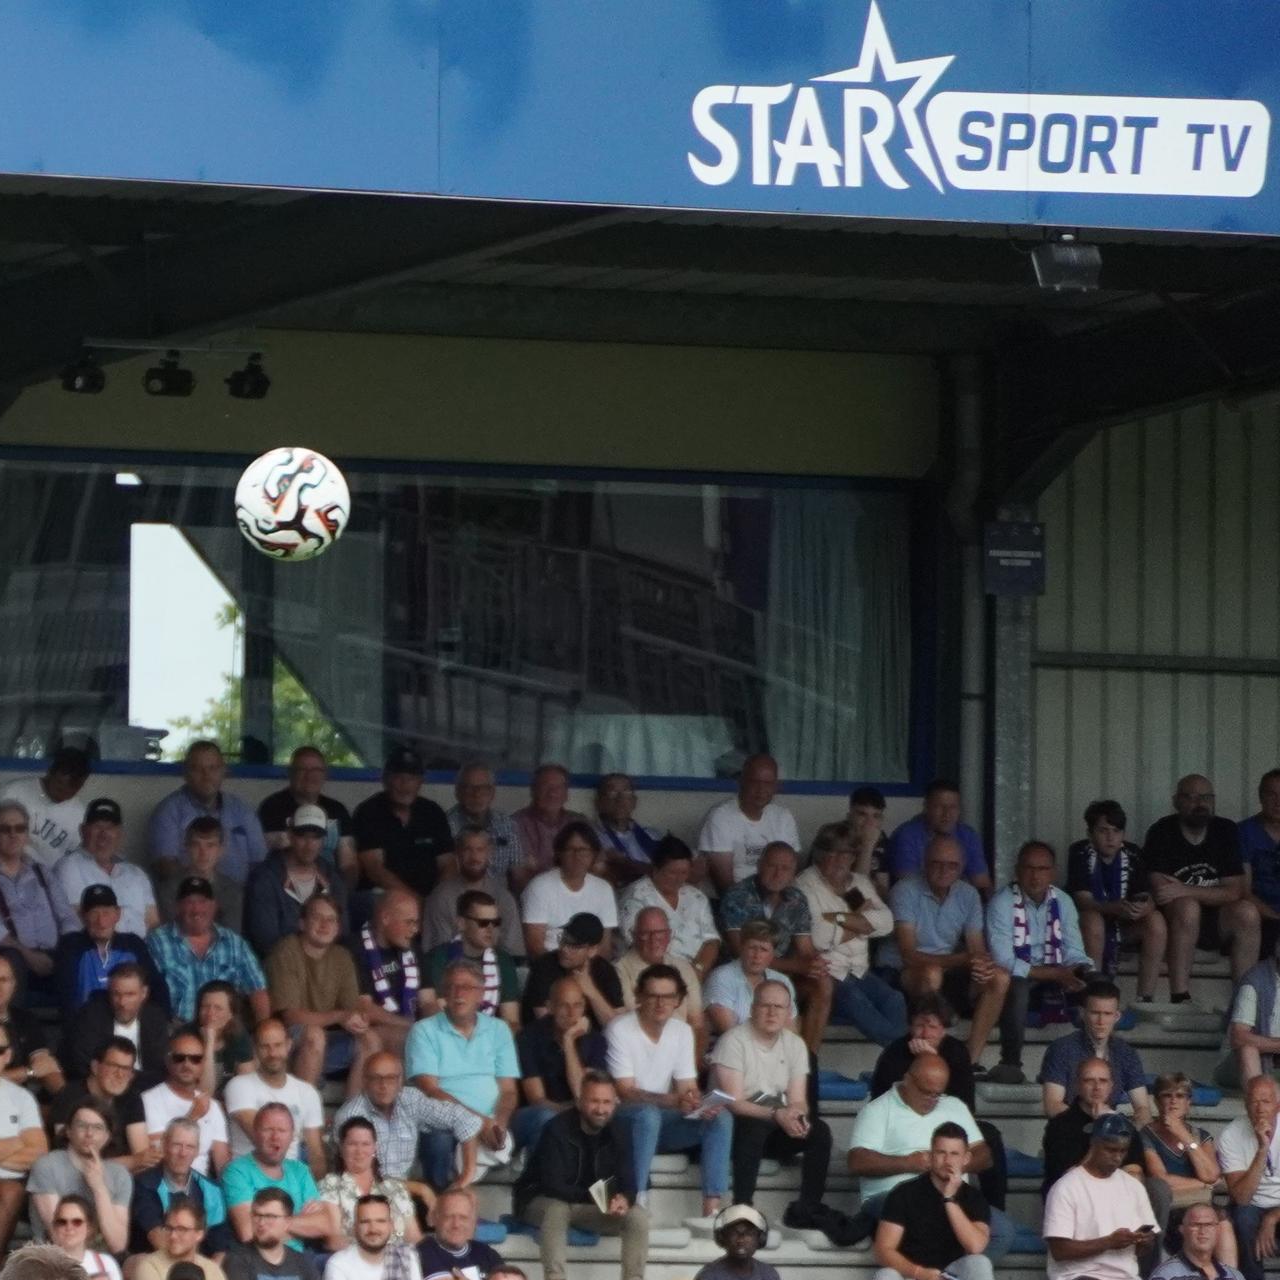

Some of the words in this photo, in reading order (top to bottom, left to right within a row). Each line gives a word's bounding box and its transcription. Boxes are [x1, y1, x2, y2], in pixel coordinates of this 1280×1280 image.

[687, 82, 911, 190] STAR
[955, 110, 1158, 176] SPORT
[1186, 123, 1252, 172] TV
